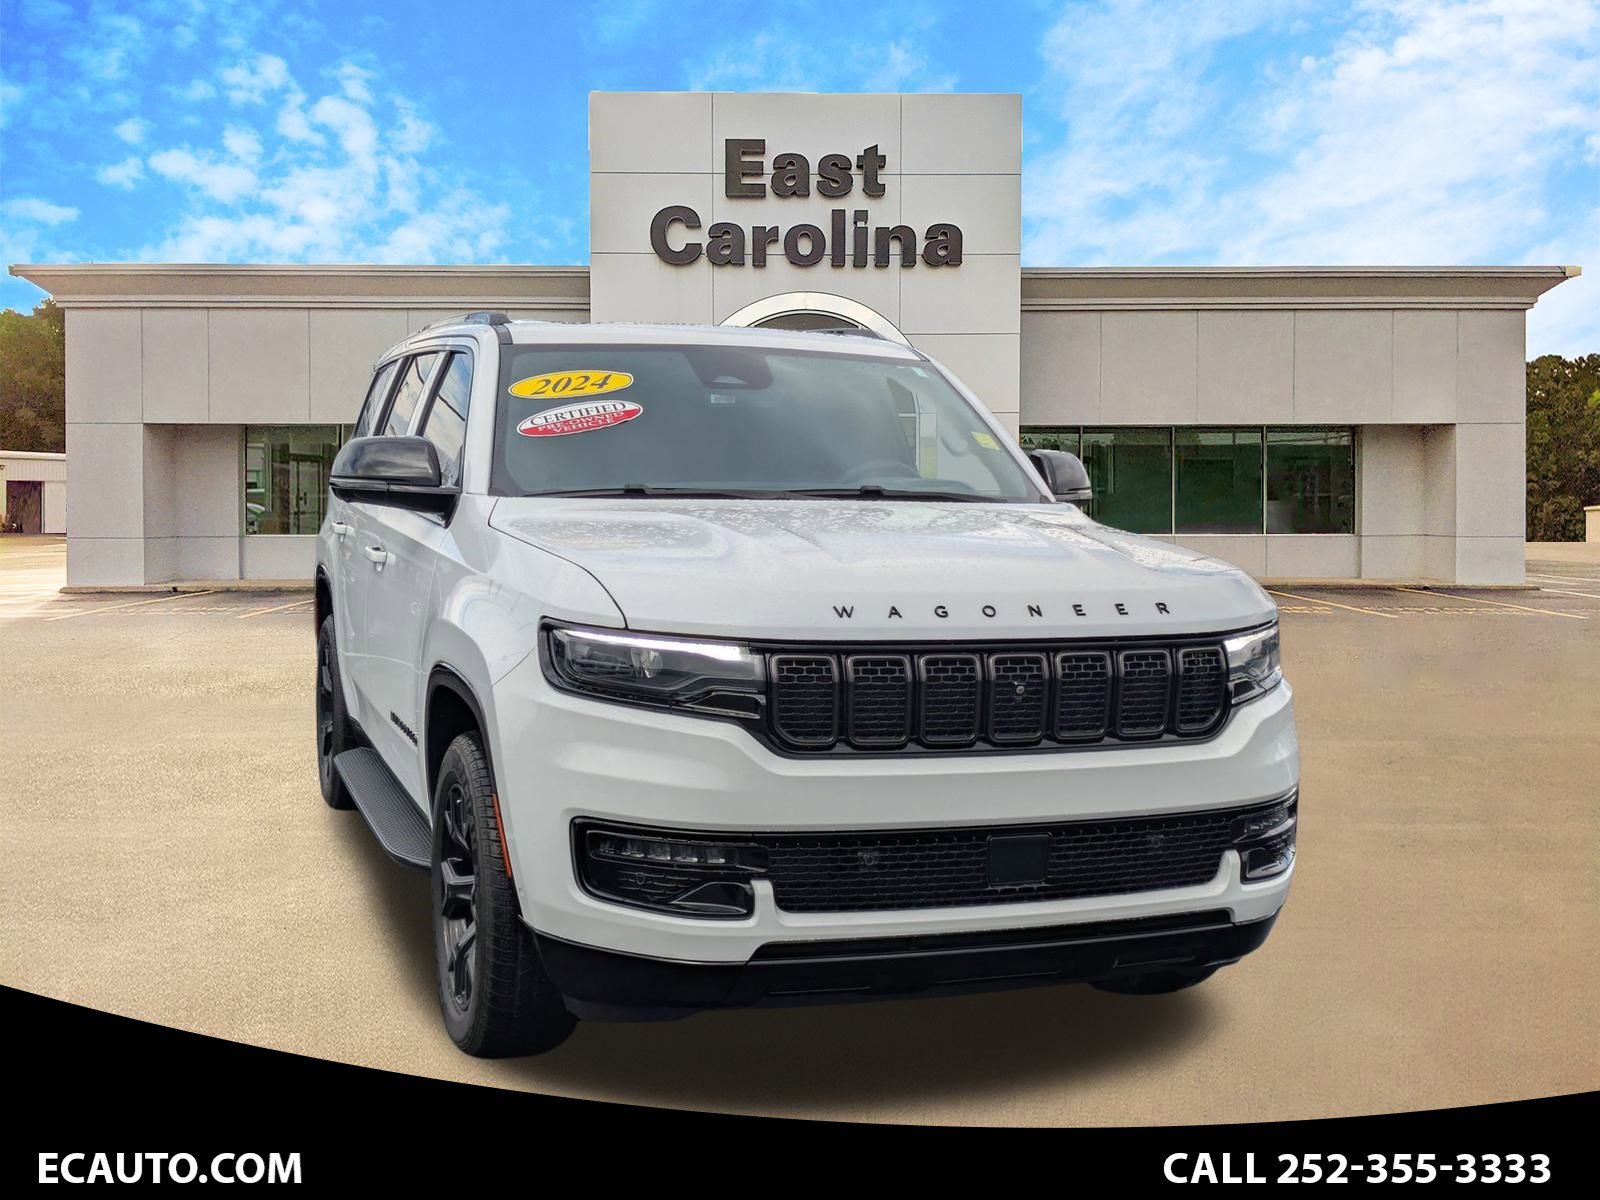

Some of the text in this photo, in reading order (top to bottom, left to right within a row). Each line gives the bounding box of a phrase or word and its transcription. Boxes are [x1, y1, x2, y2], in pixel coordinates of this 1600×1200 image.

[725, 138, 887, 198] East
[650, 205, 963, 267] Carolina
[530, 374, 612, 396] 2024
[530, 401, 626, 426] CERTIFIED
[538, 411, 625, 432] PRE-OWNED
[553, 418, 614, 433] VEHICLE
[832, 602, 1171, 619] WAGONEER
